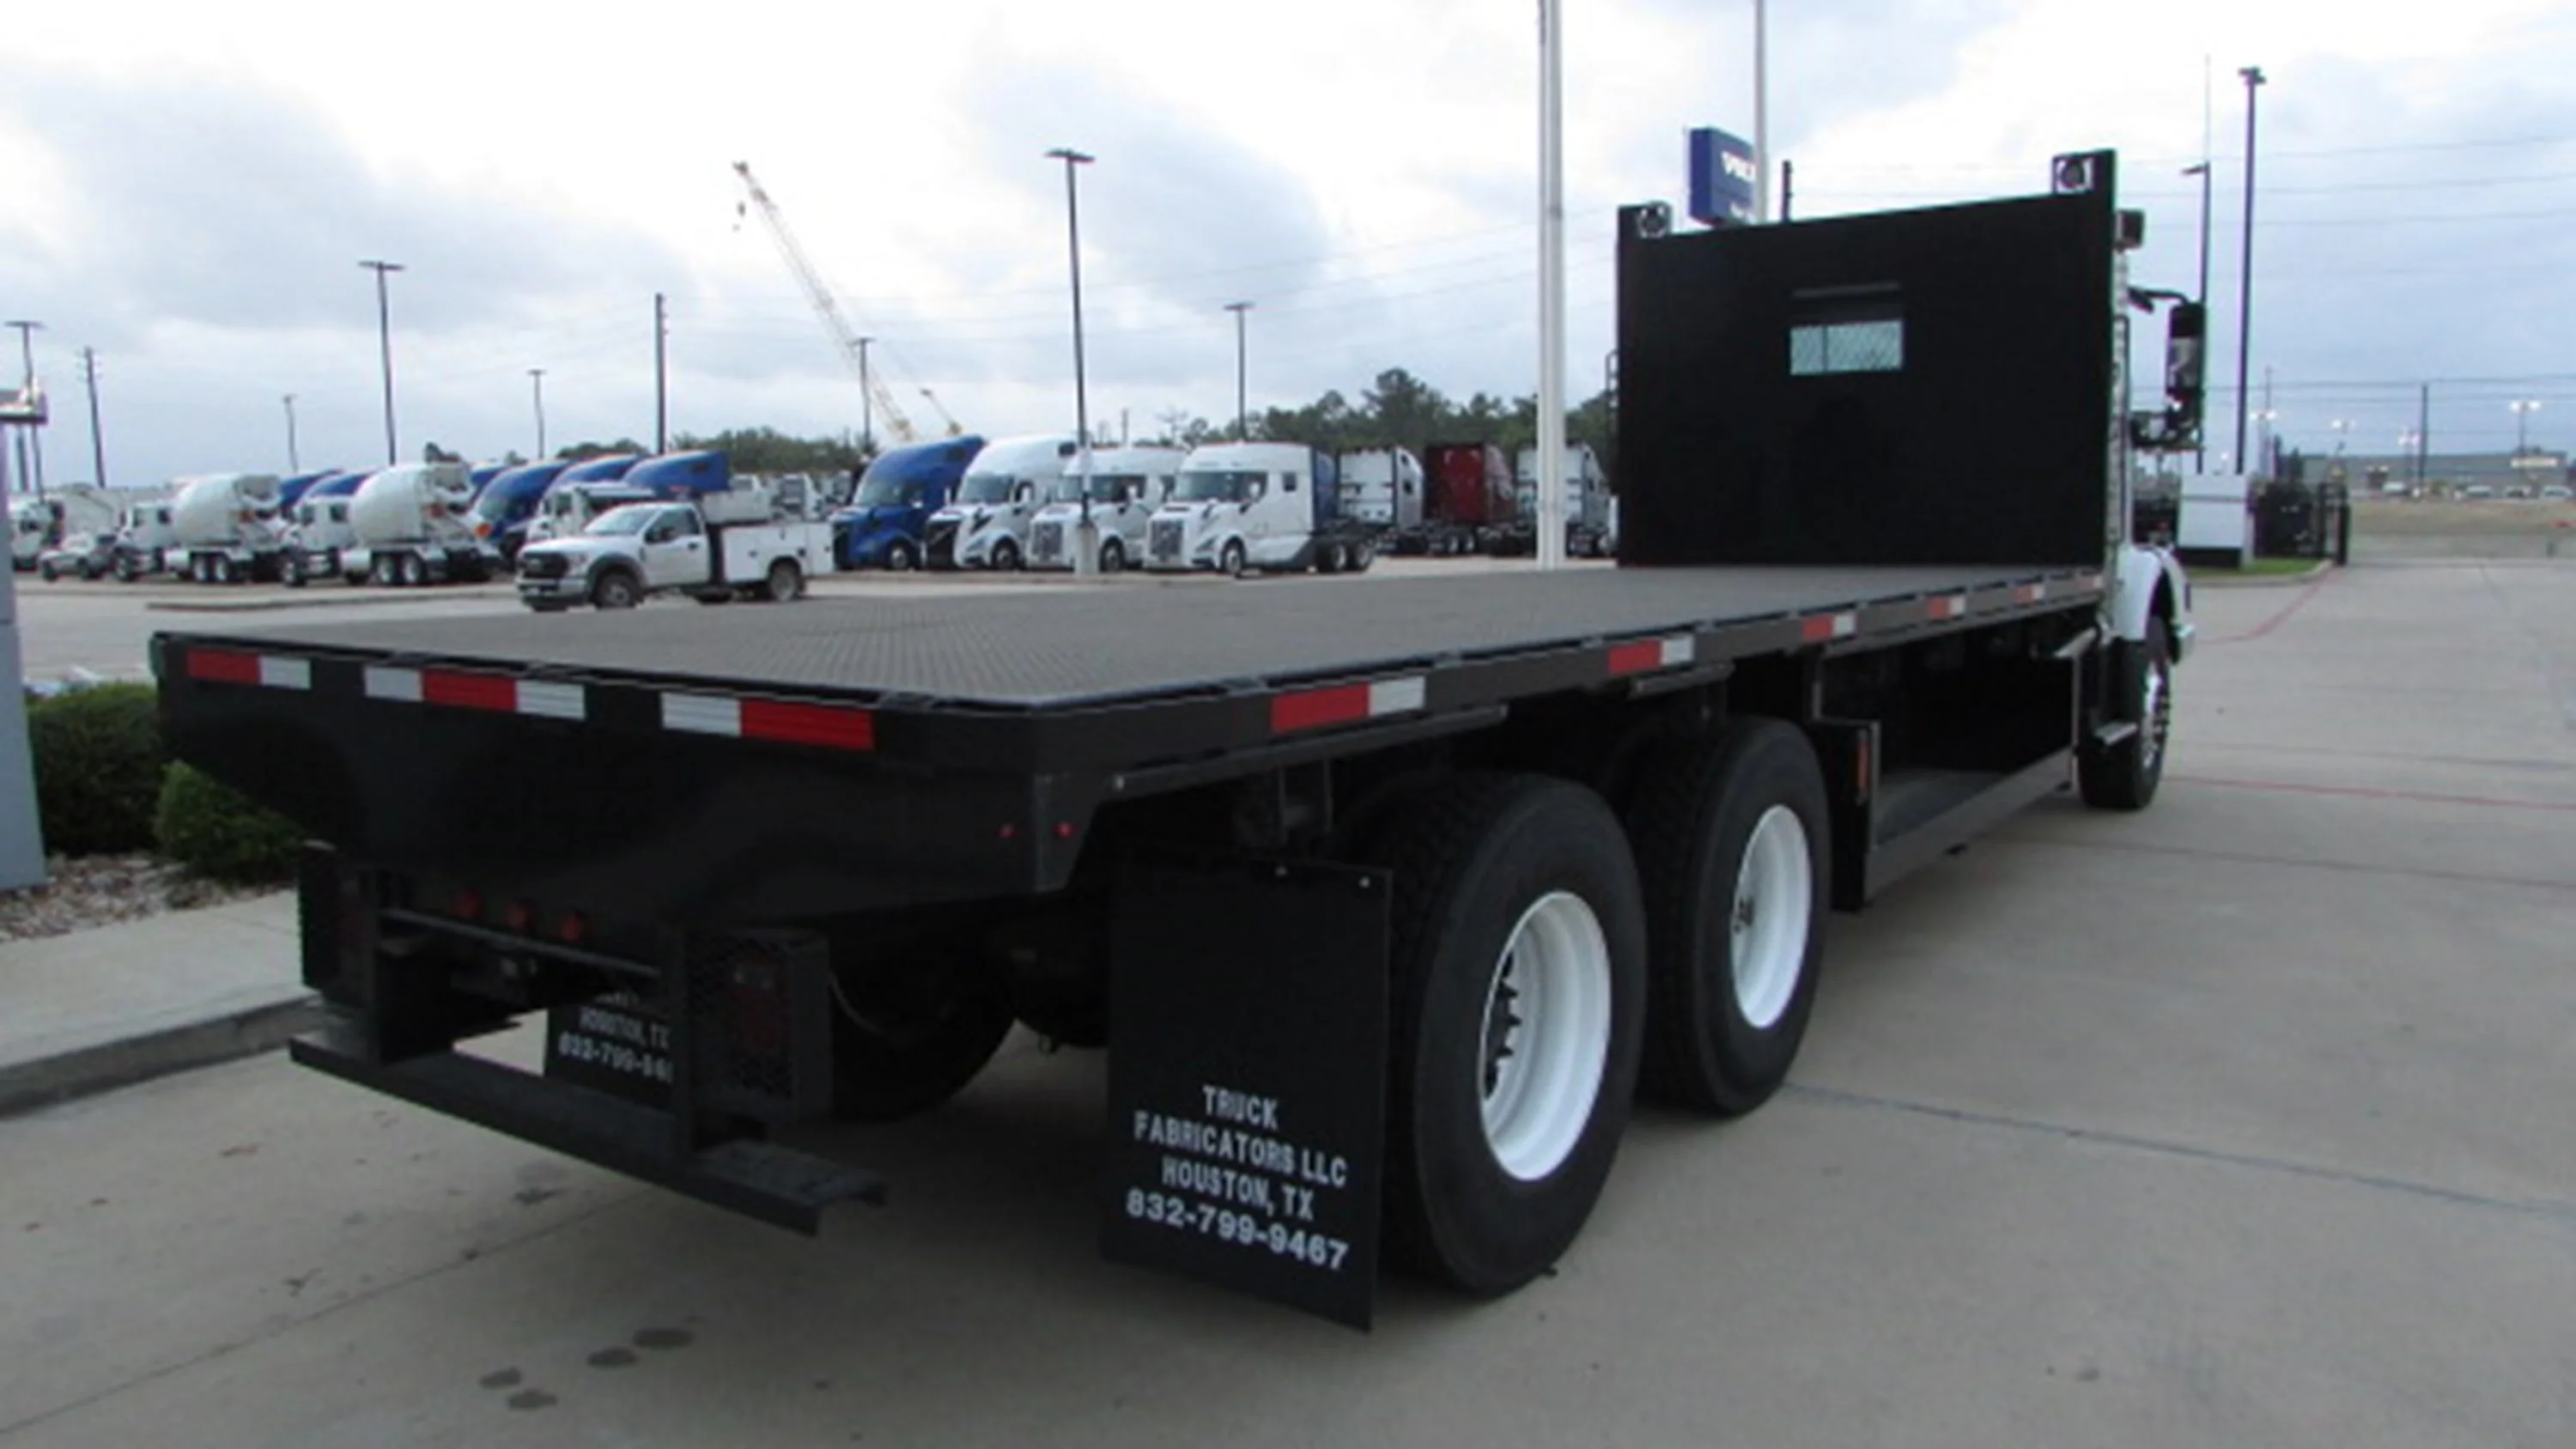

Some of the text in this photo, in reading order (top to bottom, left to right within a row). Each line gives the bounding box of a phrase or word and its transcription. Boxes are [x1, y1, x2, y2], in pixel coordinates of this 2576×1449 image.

[1203, 1084, 1279, 1130] TRUCK
[1133, 1110, 1347, 1188] FABRICATORS LLC
[1162, 1155, 1315, 1222] HOUSTON, TX
[1126, 1186, 1349, 1270] 832-799-9467
